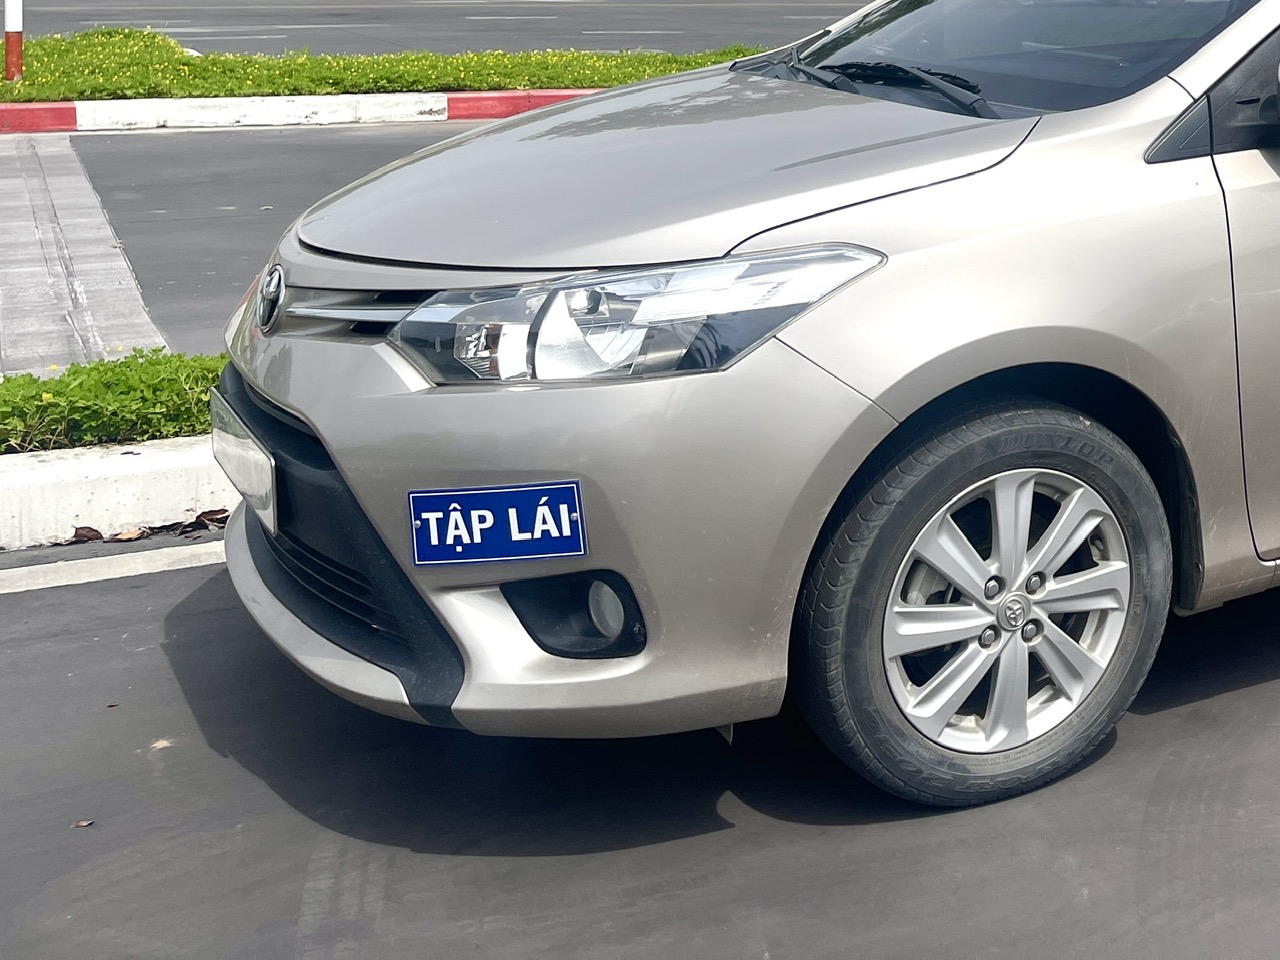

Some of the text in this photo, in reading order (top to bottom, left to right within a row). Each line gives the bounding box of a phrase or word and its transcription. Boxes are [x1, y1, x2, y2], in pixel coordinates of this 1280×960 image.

[999, 432, 1116, 466] DUNLOP
[420, 496, 572, 553] TẬP LÁI
